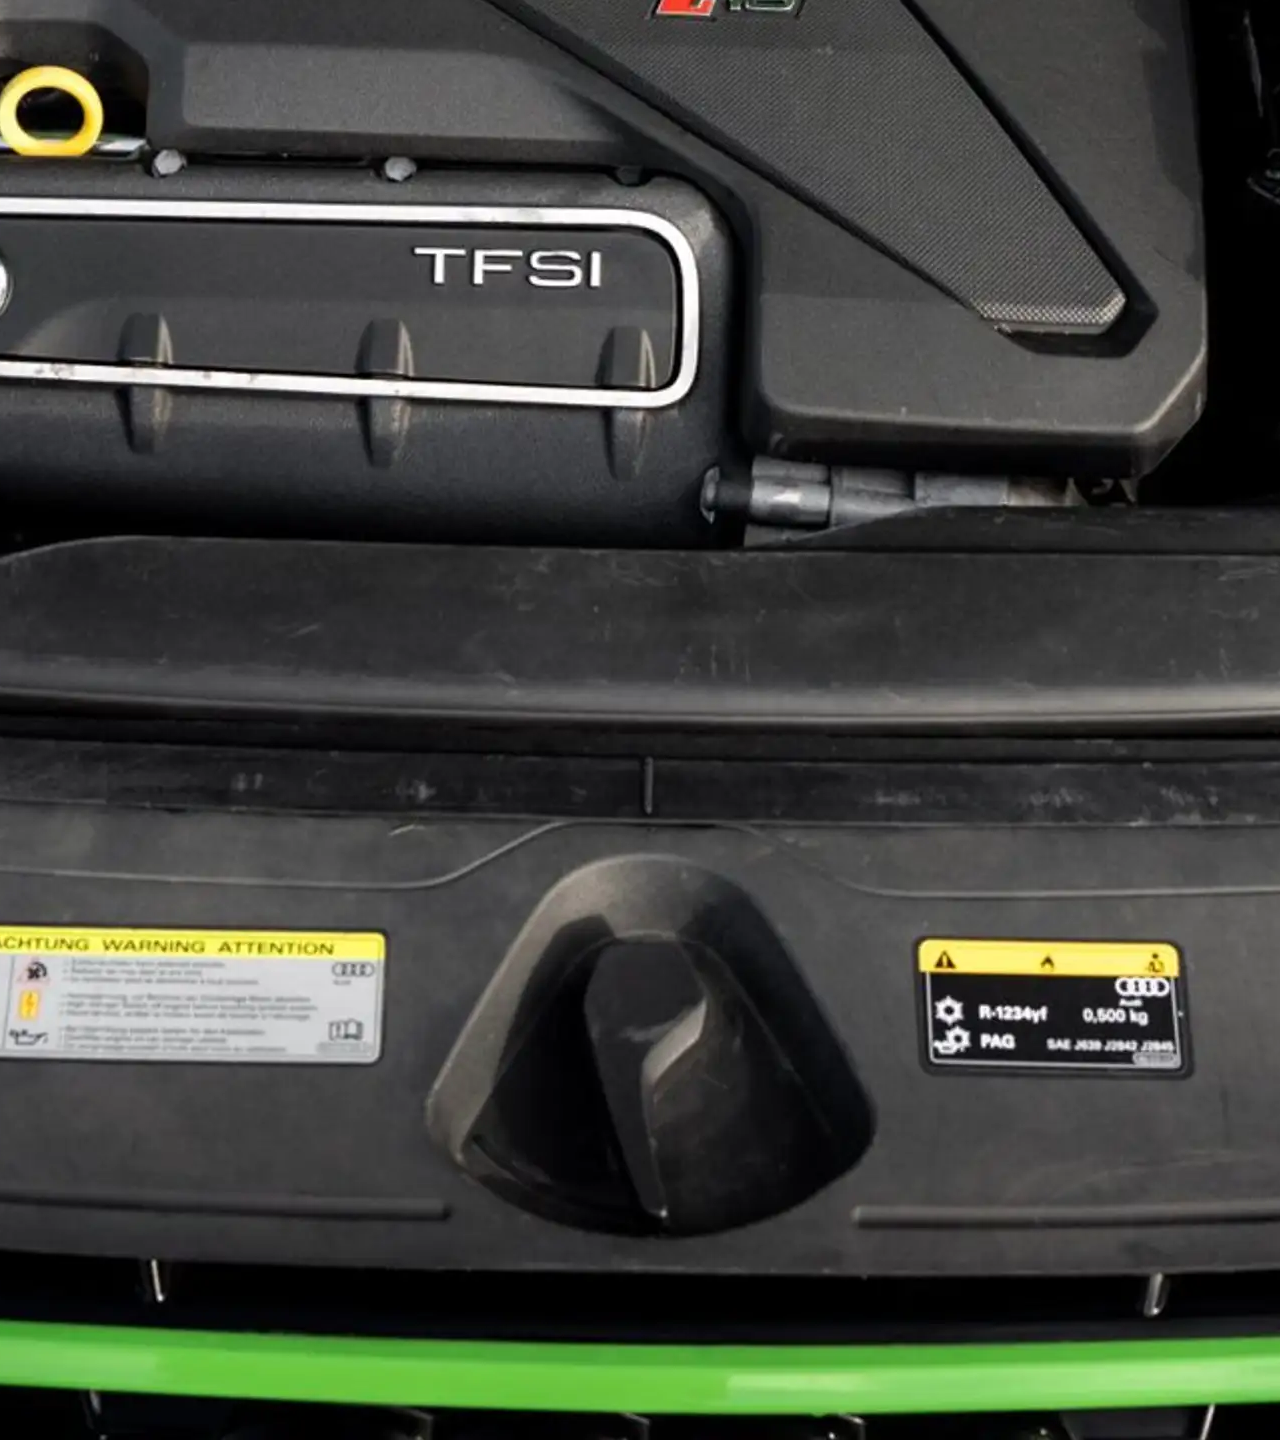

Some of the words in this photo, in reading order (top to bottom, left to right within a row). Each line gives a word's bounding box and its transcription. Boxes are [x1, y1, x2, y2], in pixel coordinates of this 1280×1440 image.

[413, 246, 602, 288] TFSI
[102, 938, 206, 953] WARNING
[217, 940, 335, 956] ATTENTION
[978, 1004, 1049, 1024] R-1234yf
[1082, 1007, 1126, 1024] 0,500
[1129, 1008, 1149, 1026] kg
[979, 1032, 1016, 1050] PAG
[1046, 1037, 1072, 1051] SAE
